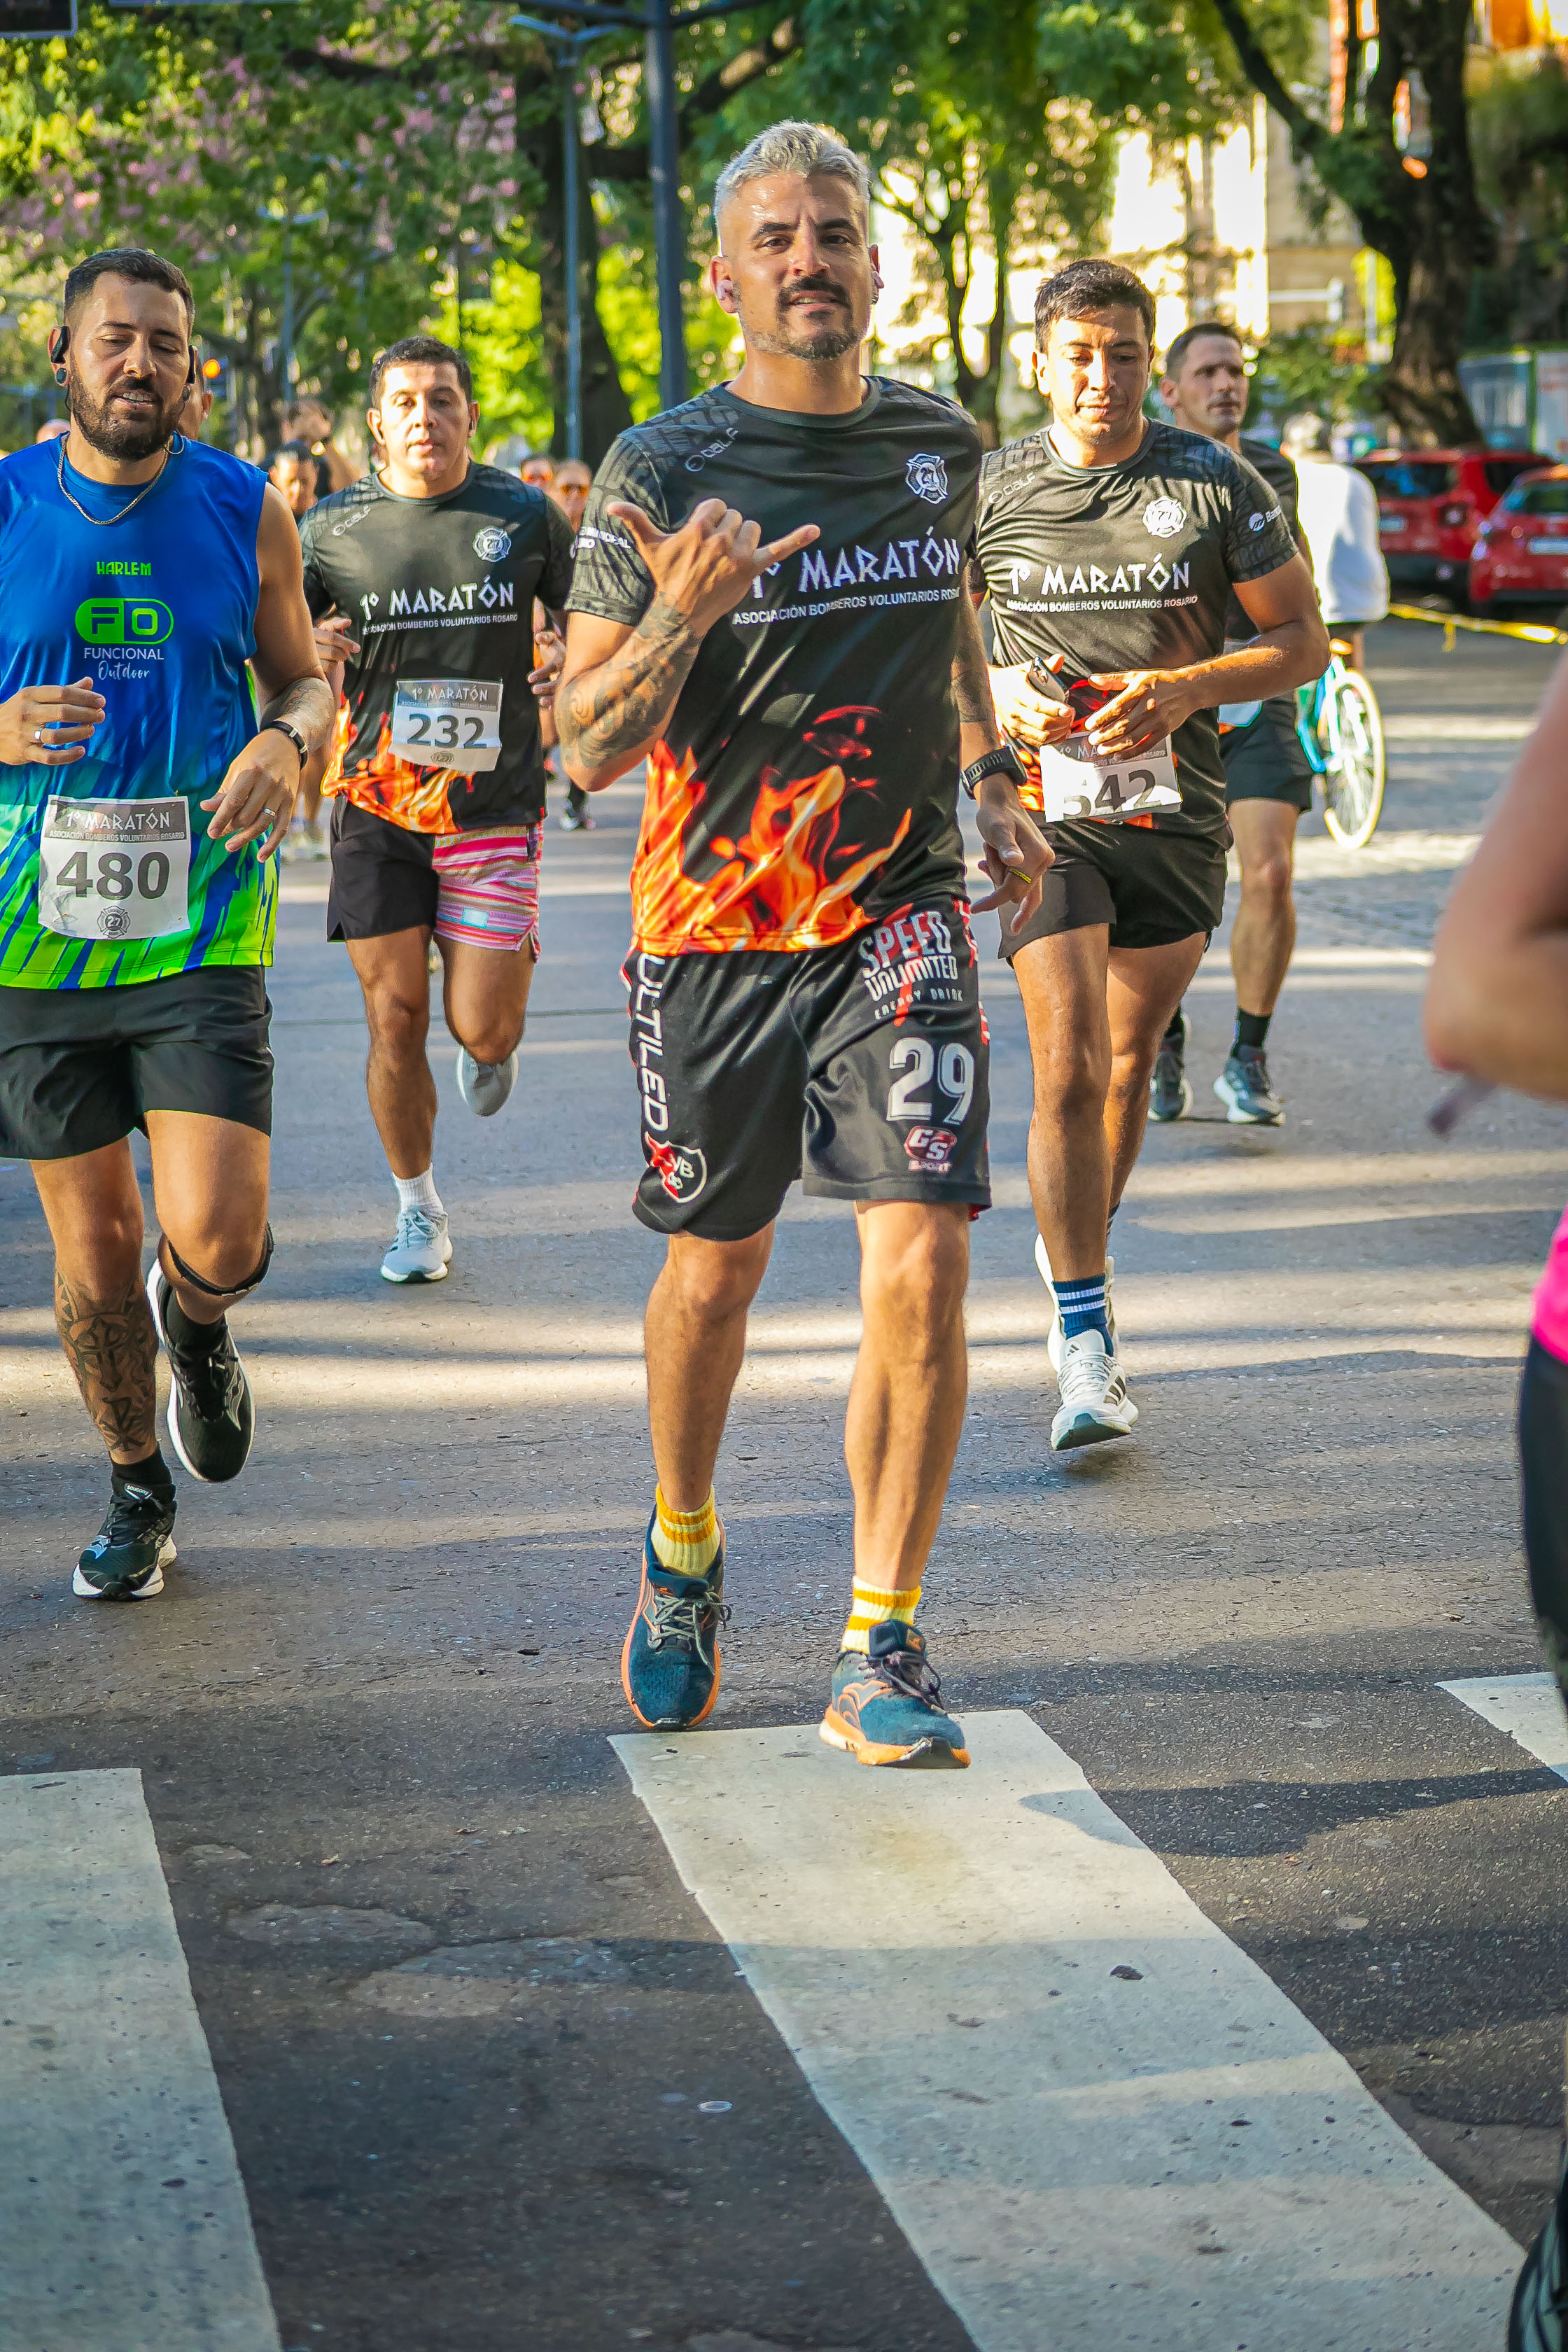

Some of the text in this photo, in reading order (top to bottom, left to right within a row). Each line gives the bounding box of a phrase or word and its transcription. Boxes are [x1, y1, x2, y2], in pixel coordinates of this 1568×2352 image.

[96, 561, 151, 575] HARLEM
[798, 526, 960, 592] MARATÓN
[1041, 552, 1190, 595] MARATÓN
[388, 575, 514, 617] MARATÓN
[732, 605, 806, 625] ASOCIACIÓN
[869, 589, 939, 606] VOLUNTARIOS
[1049, 599, 1100, 612] BOMBEROS
[1101, 598, 1162, 611] VOLUNTARIOS
[1163, 594, 1198, 608] ROSARIO
[397, 619, 439, 630] BOMBEROS
[440, 615, 491, 627] VOLUNTARIOS
[492, 613, 519, 623] ROSARIO
[83, 647, 164, 660] FUNCIONAL
[97, 659, 150, 680] Outdoor
[428, 684, 488, 701] MARATÓN
[407, 713, 487, 749] 232
[84, 807, 171, 831] MARATÓN
[56, 851, 170, 901] 480
[107, 915, 121, 927] 27
[858, 911, 952, 979] SPEED
[864, 955, 958, 1002] UNLIMITED
[636, 952, 668, 1132] ULTILED
[886, 1037, 975, 1126] 29
